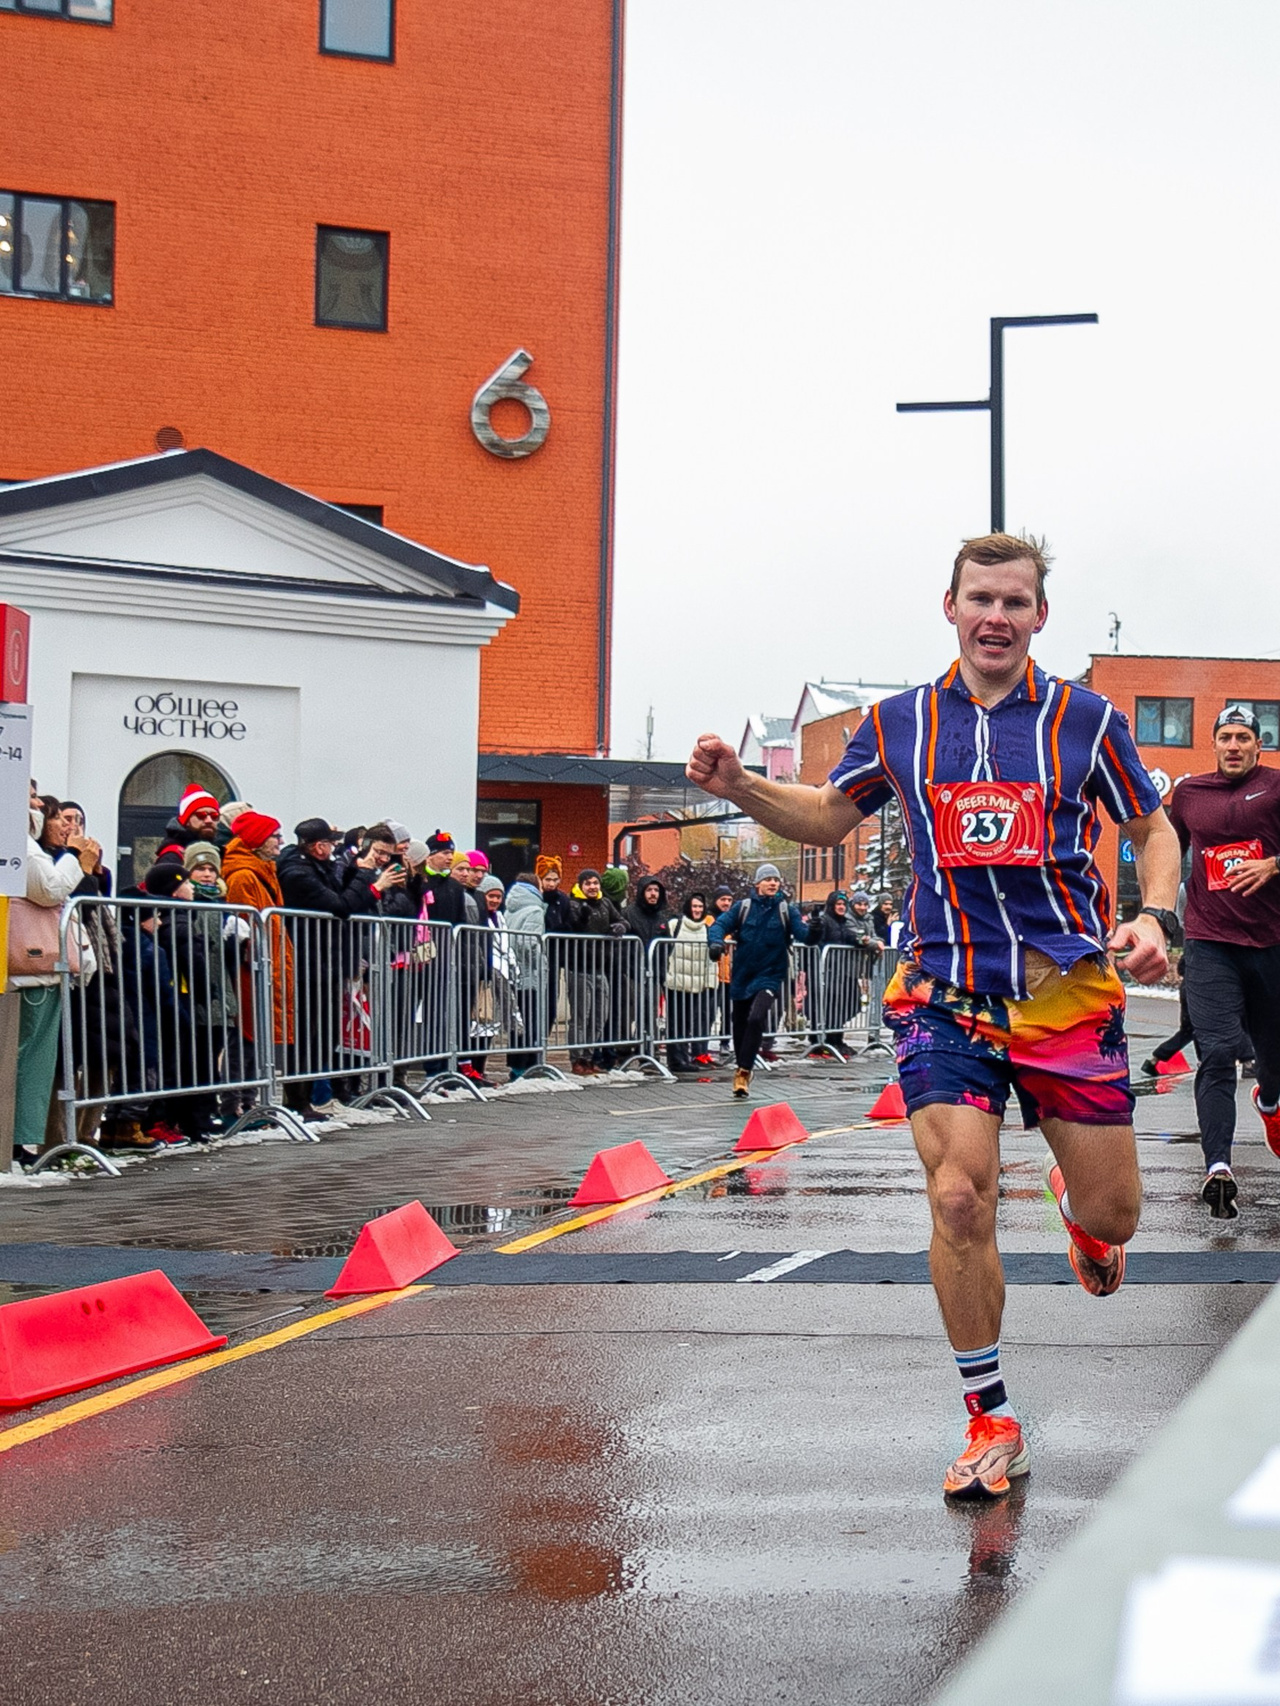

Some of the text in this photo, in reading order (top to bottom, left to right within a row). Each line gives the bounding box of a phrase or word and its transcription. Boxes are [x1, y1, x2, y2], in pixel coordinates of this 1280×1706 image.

[470, 347, 551, 459] 6
[134, 692, 239, 719] общее
[123, 715, 247, 741] частное
[0, 747, 22, 761] -14
[956, 795, 1021, 814] BEER MILE
[961, 812, 1015, 843] 237
